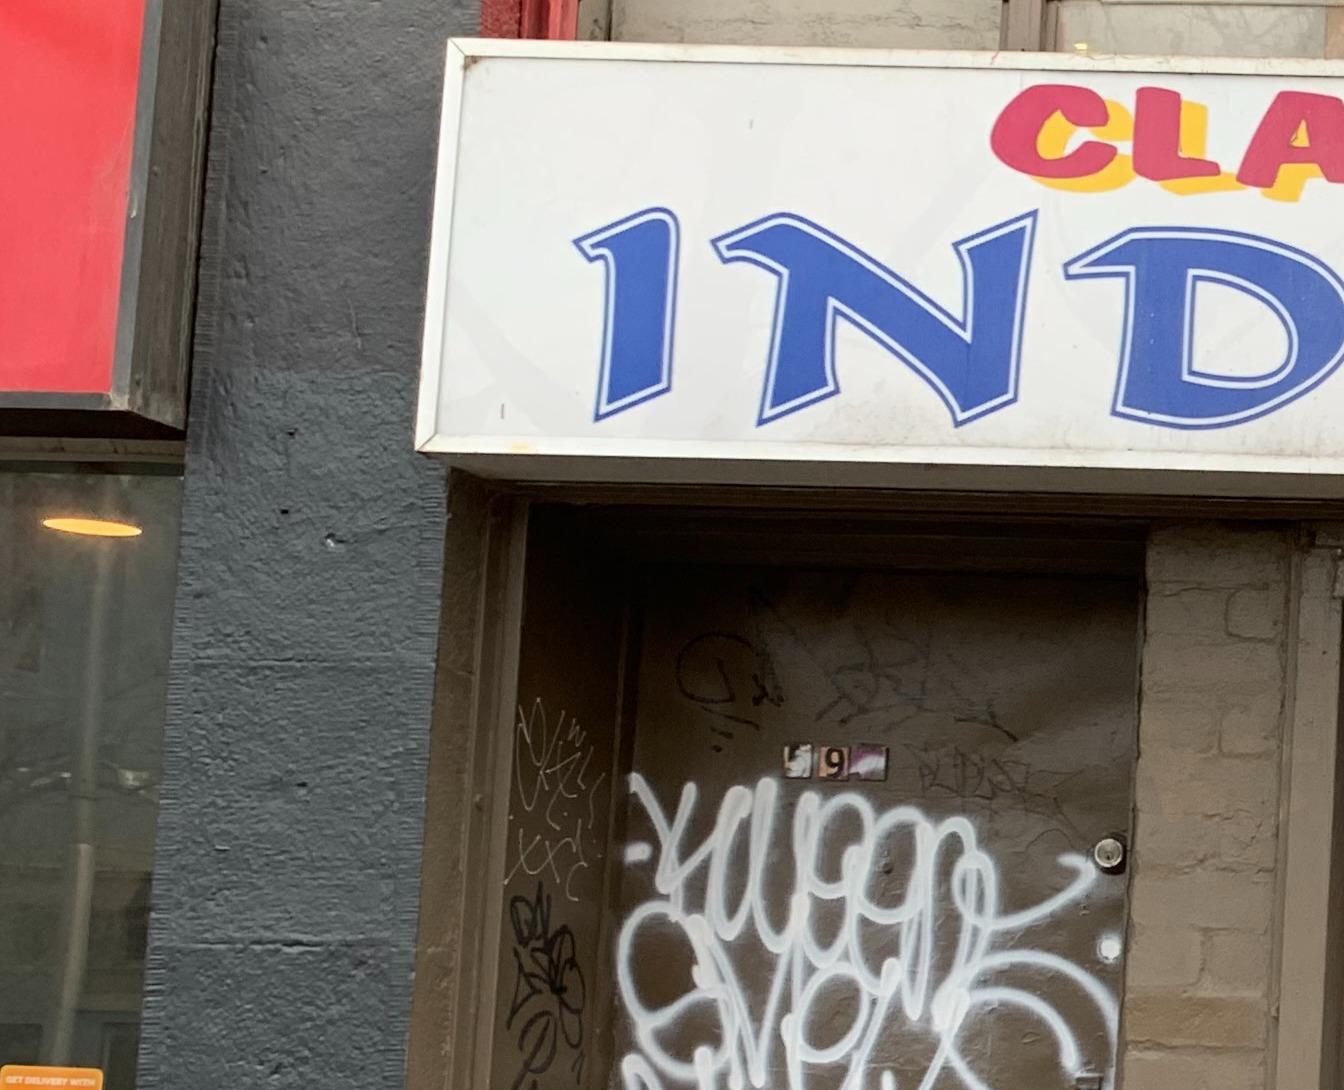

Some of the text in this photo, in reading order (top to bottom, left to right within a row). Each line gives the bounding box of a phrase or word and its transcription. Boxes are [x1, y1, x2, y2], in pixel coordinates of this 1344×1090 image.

[5, 1075, 96, 1086] GET DELIVERY WITH
